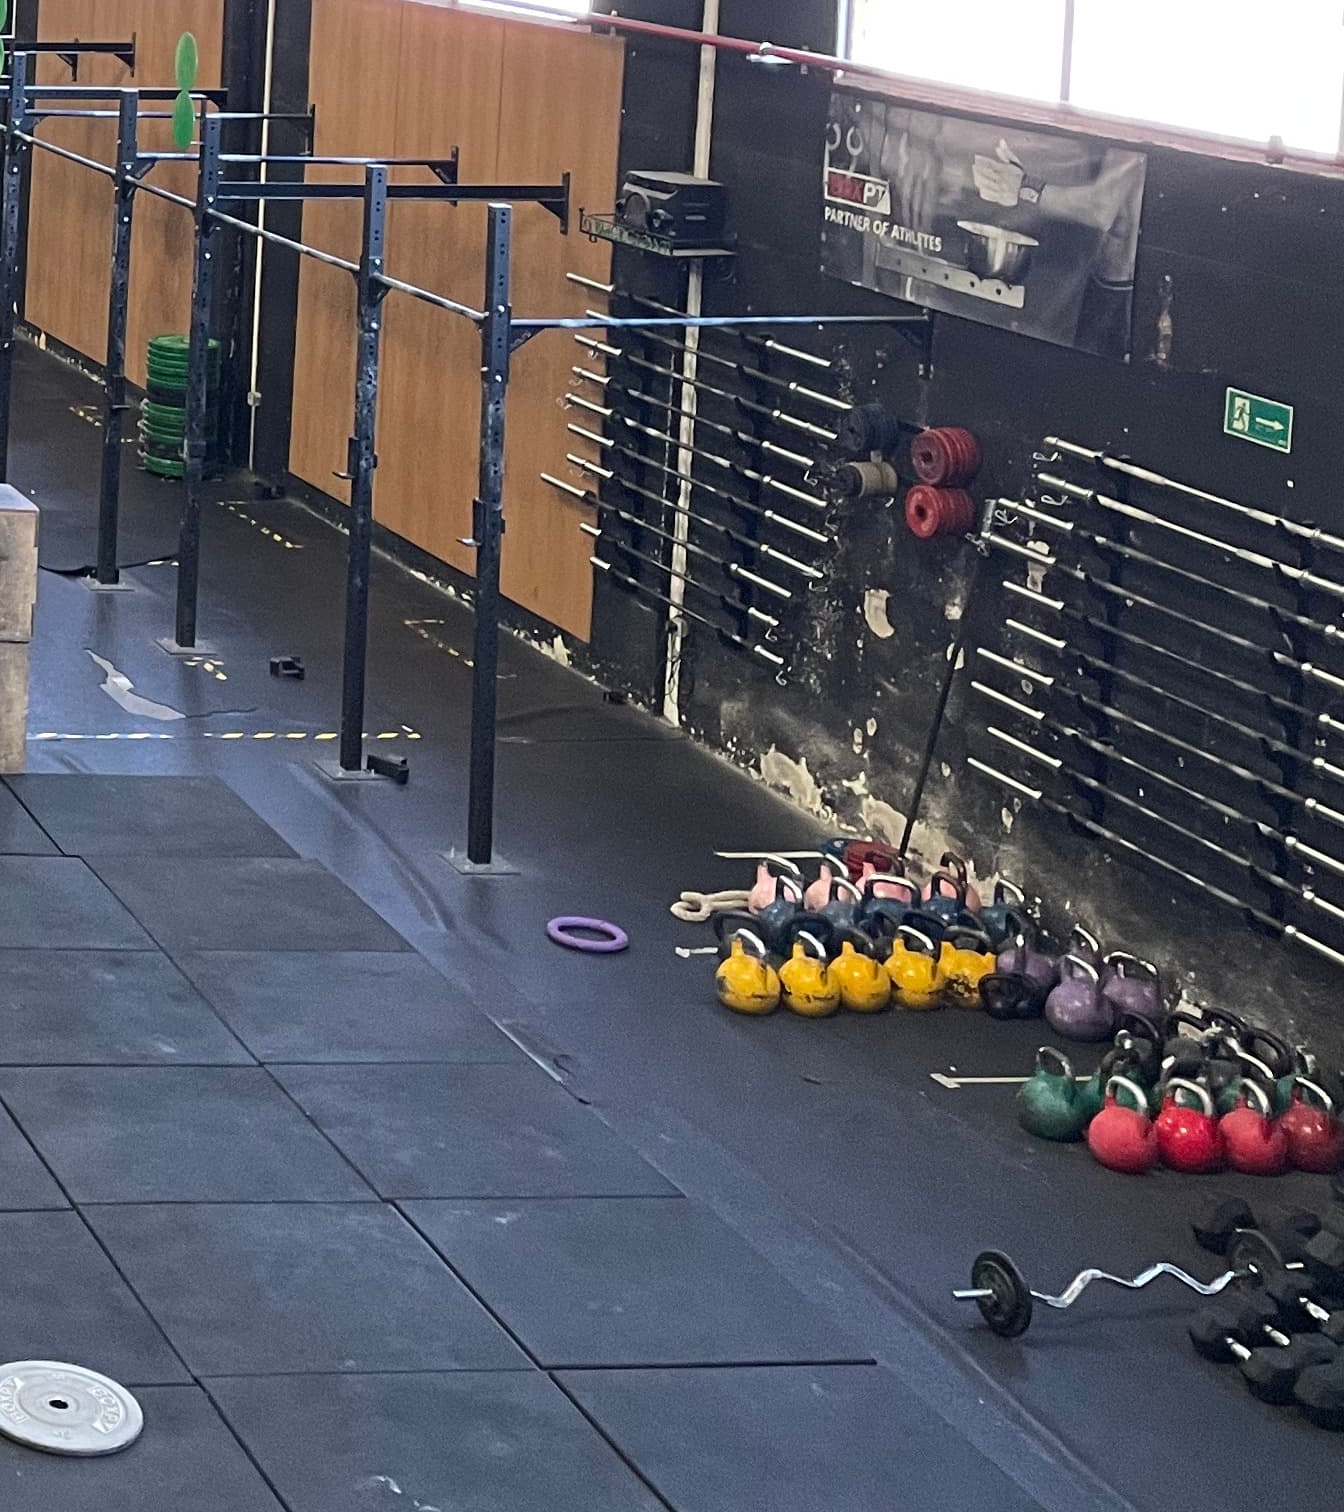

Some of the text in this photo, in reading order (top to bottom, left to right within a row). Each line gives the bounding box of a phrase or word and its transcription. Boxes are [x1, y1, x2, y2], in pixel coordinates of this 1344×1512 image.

[824, 206, 943, 252] PARTNER OF ATHLETES
